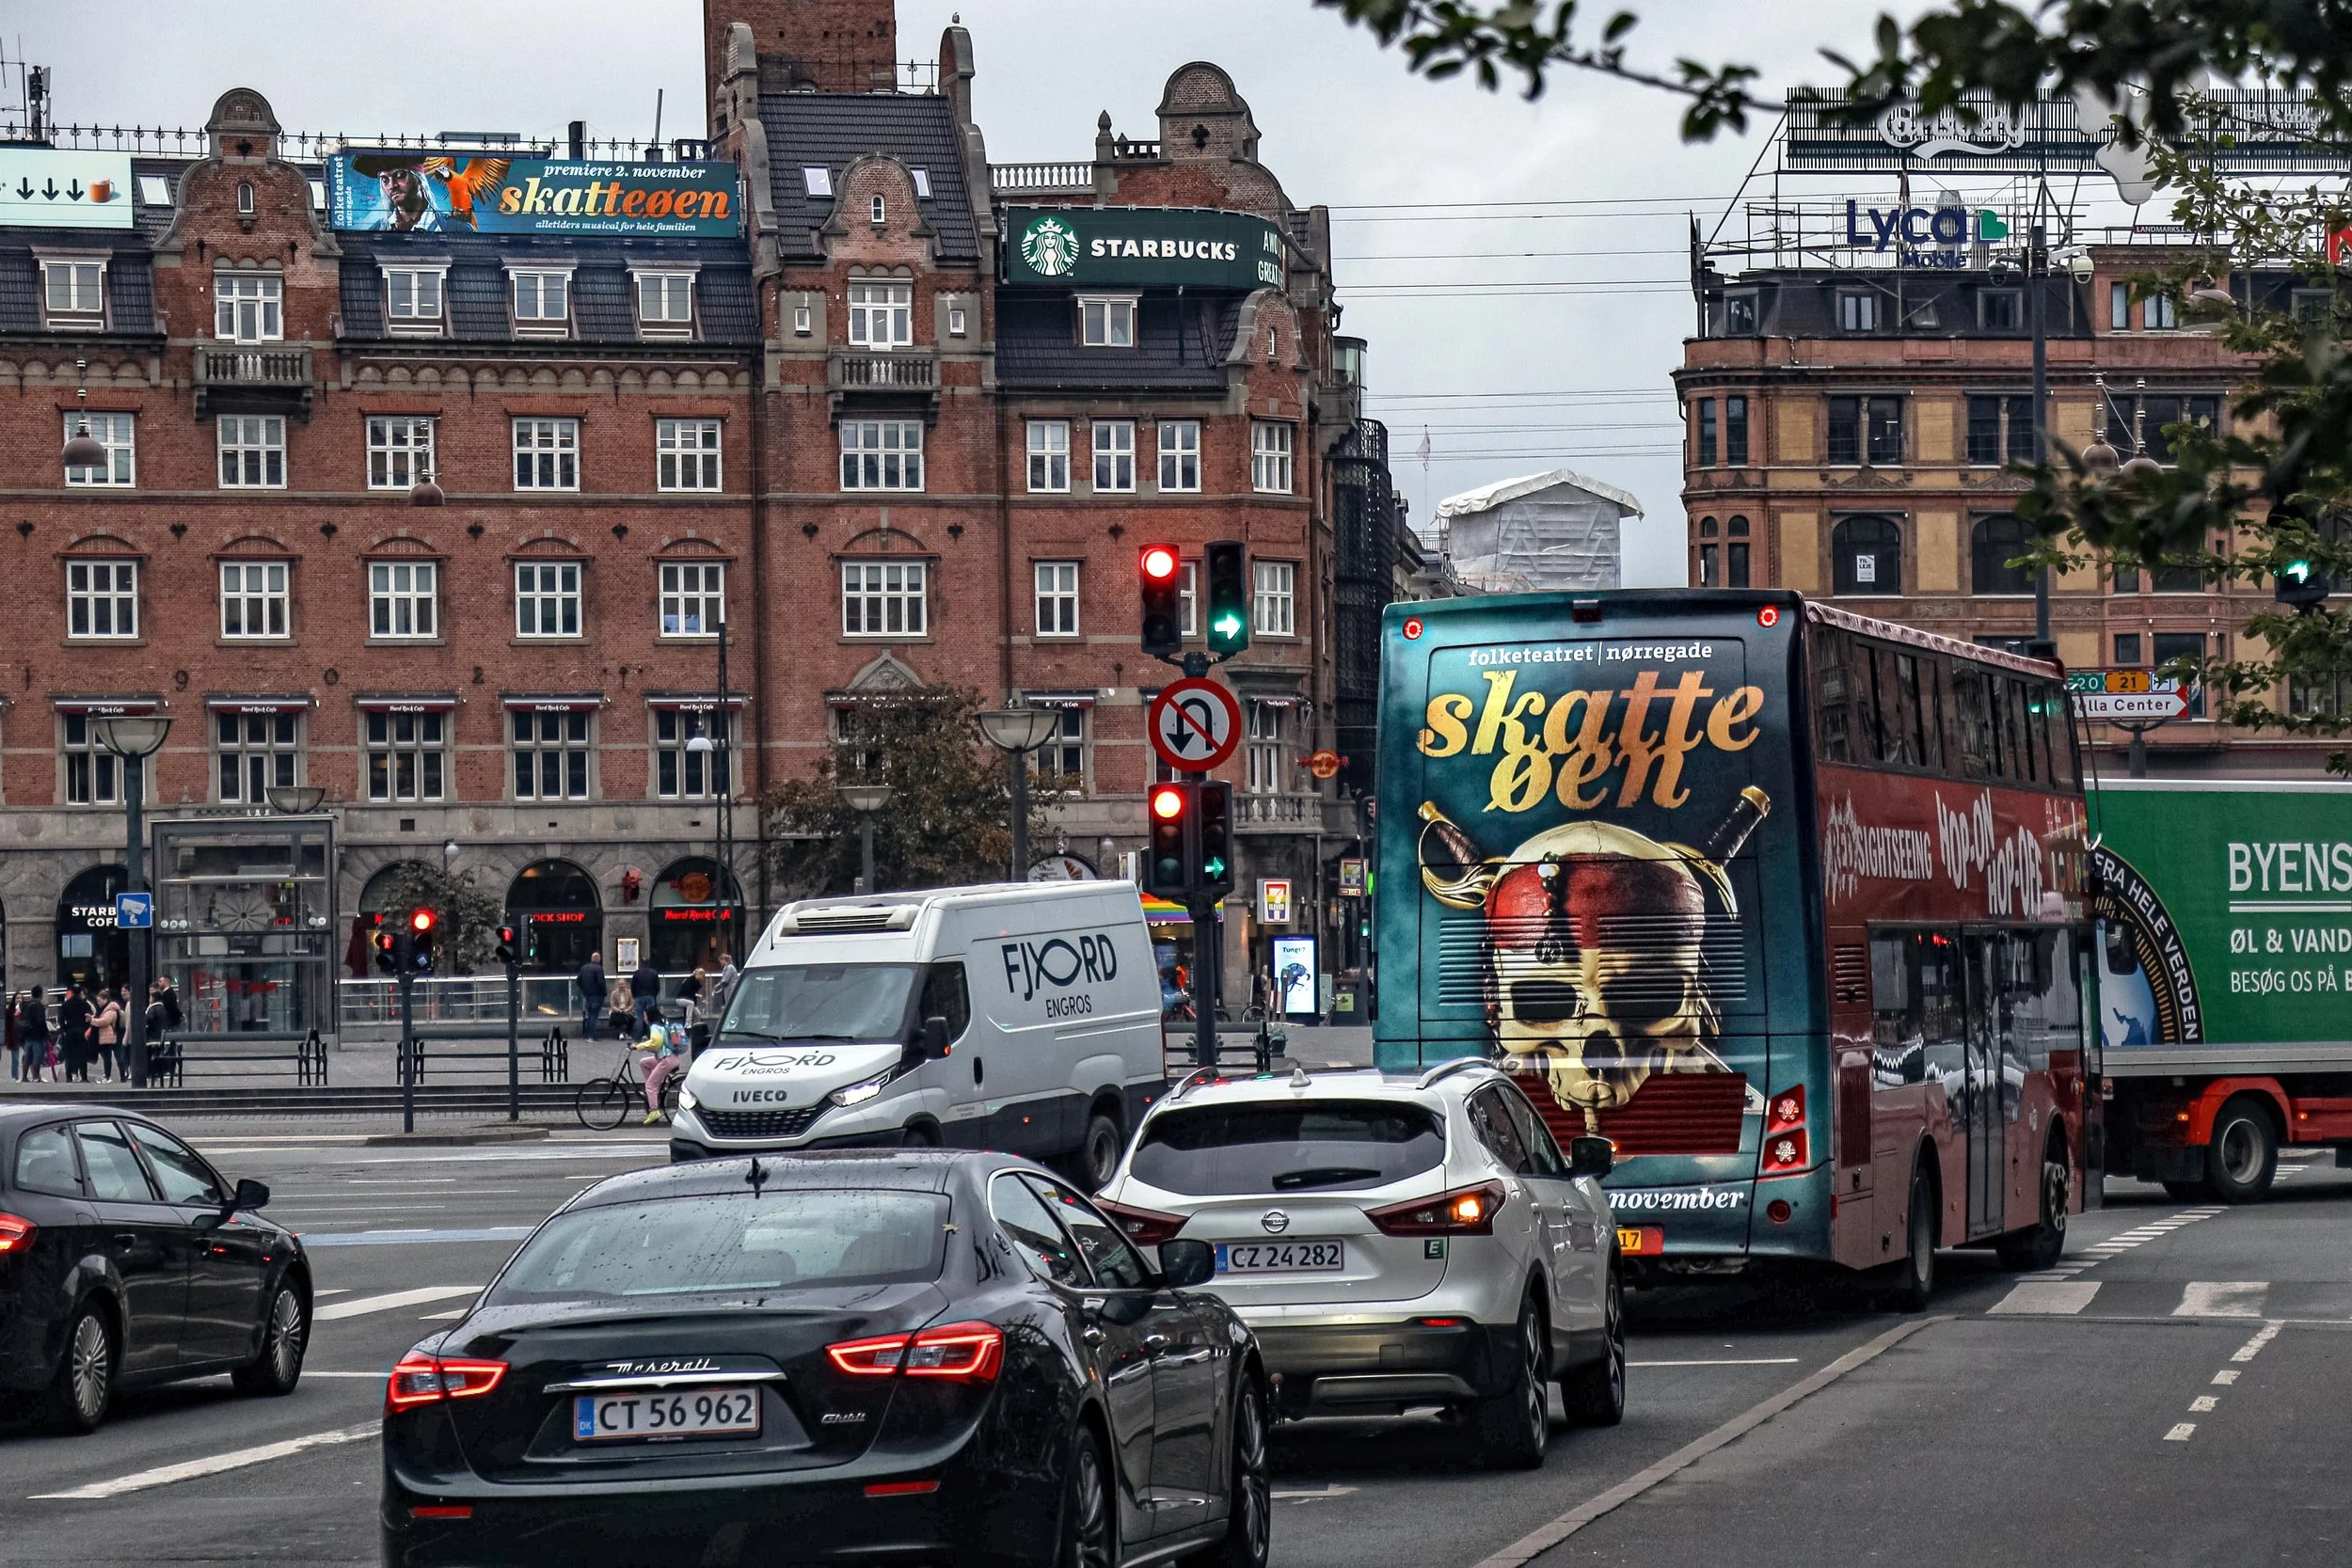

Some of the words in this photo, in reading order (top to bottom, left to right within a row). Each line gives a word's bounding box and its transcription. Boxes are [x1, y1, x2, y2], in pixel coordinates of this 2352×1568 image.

[544, 164, 612, 177] premiere
[614, 166, 628, 177] 2.
[632, 164, 706, 179] november
[334, 156, 344, 226] folketeatret
[498, 178, 731, 219] skatteøen
[535, 220, 580, 230] alletiders
[581, 221, 619, 230] musical
[617, 222, 634, 232] for
[636, 223, 654, 231] hele
[653, 223, 696, 232] familien
[1847, 199, 1967, 253] Lyca
[1090, 238, 1236, 261] STARBUCKS
[1902, 250, 1967, 268] Mobile
[1469, 643, 1594, 667] folketeatret
[1605, 641, 1712, 662] nørregade
[2120, 676, 2137, 689] 21
[1416, 670, 1765, 758] skatte
[2114, 699, 2171, 711] Center
[1482, 749, 1691, 814] øen
[1935, 787, 1995, 889] HOP-ON
[1855, 825, 1933, 879] SIGHTSEEING
[1987, 825, 2043, 916] HOP-OFF
[2228, 842, 2352, 893] BYENS
[72, 907, 117, 916] STARB
[87, 917, 118, 927] COF
[532, 912, 554, 922] OCK
[556, 912, 585, 922] SHOP
[664, 909, 689, 920] Hard
[689, 909, 711, 921] Rock
[2230, 928, 2258, 954] ØL
[2265, 929, 2284, 954] &
[2290, 928, 2352, 953] VAND
[2128, 879, 2168, 938] HELE
[2164, 936, 2199, 1040] VERDEN
[2231, 967, 2285, 995] BESØG
[2291, 970, 2312, 992] OS
[2318, 964, 2338, 991] PÅ
[1045, 994, 1092, 1019] ENGROS
[733, 1090, 787, 1102] IVECO
[1609, 1187, 1744, 1210] november
[1232, 1247, 1261, 1268] CZ
[1266, 1245, 1294, 1267] 24
[1298, 1243, 1340, 1266] 282
[1428, 1241, 1440, 1255] E
[607, 1358, 721, 1373] Maserati
[579, 1421, 592, 1432] DK
[598, 1400, 640, 1431] CT
[649, 1396, 687, 1428] 56
[694, 1393, 754, 1426] 962
